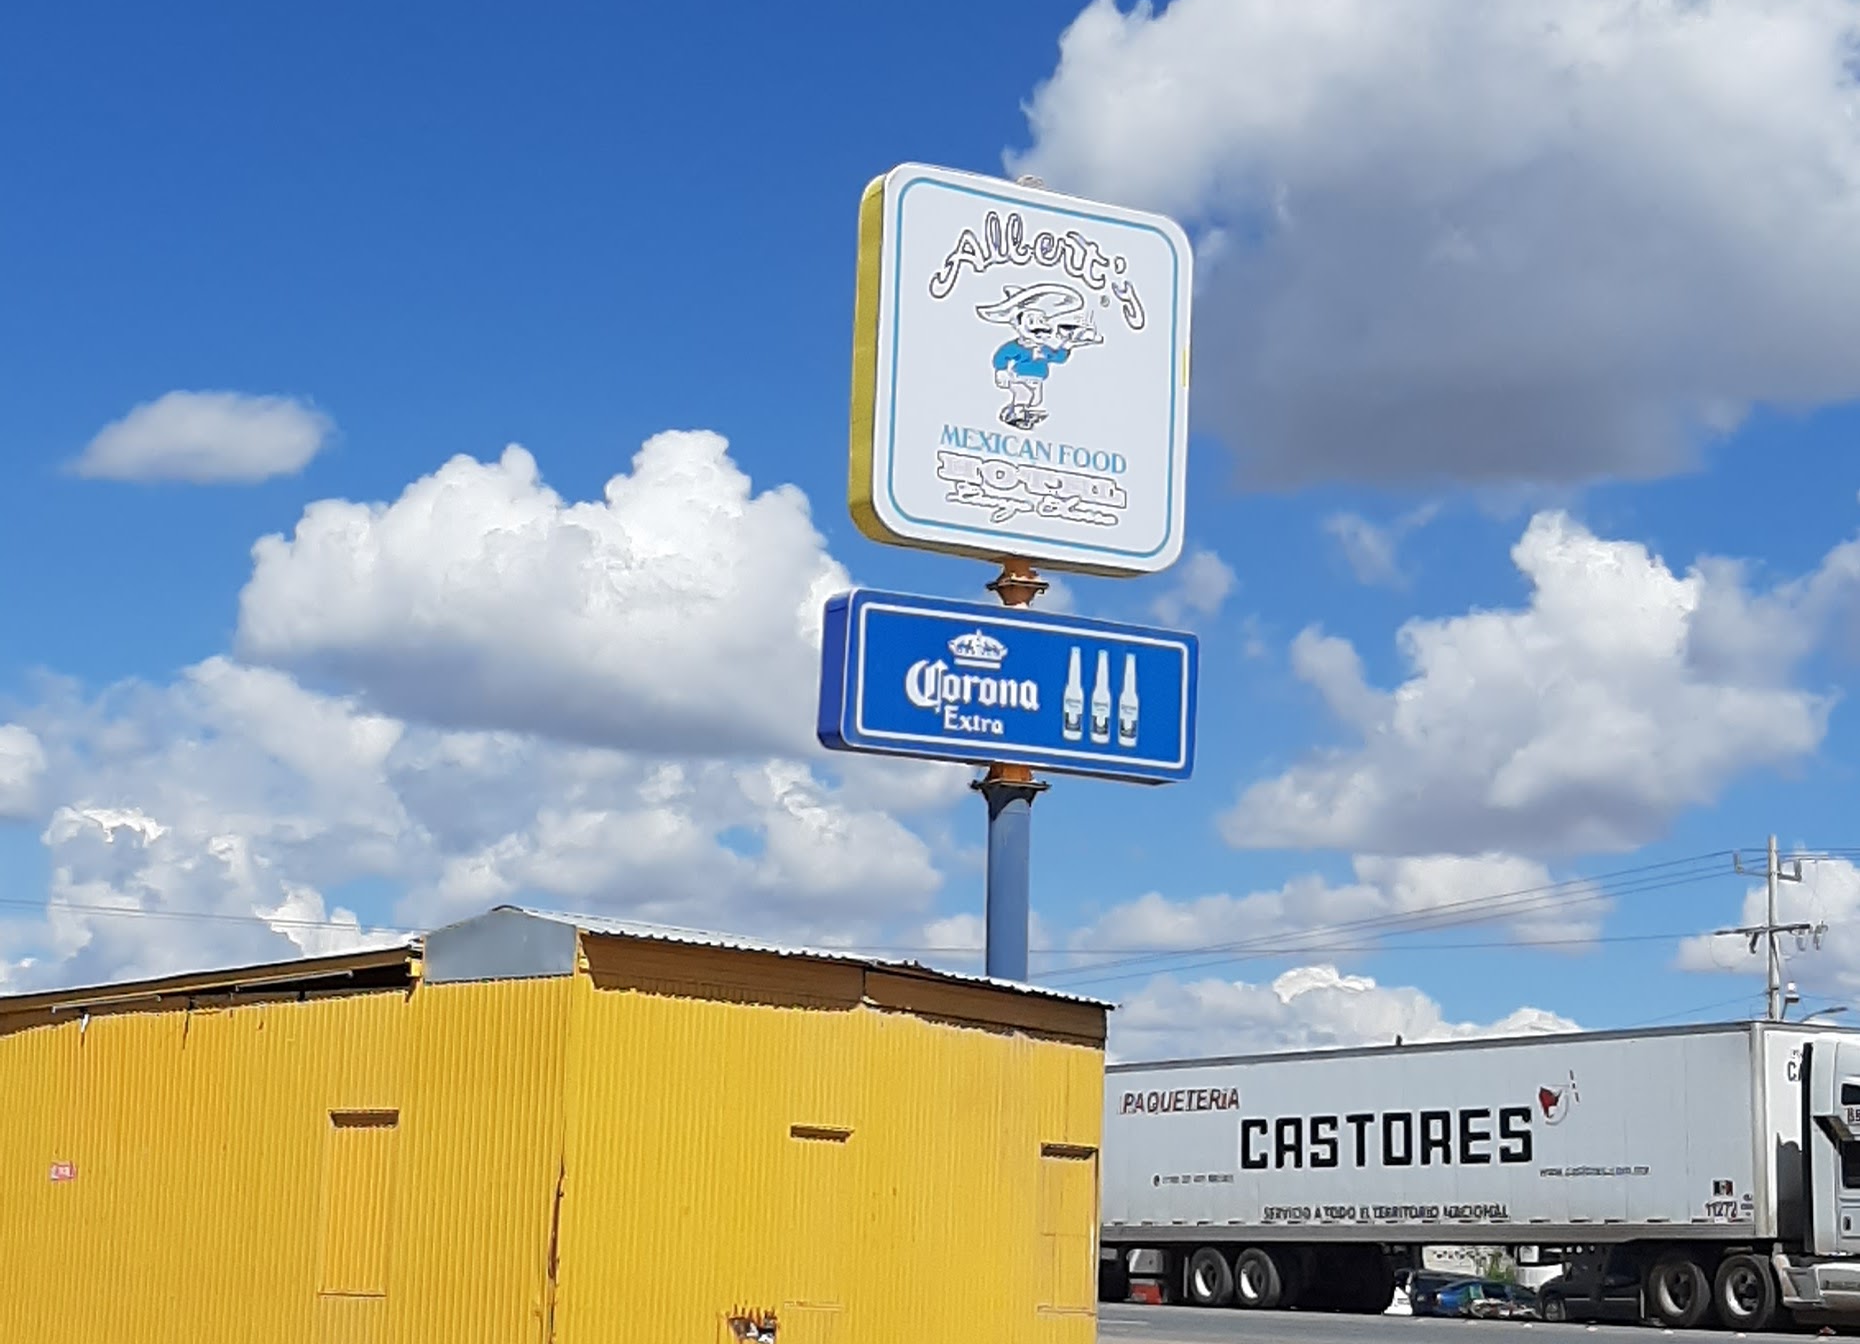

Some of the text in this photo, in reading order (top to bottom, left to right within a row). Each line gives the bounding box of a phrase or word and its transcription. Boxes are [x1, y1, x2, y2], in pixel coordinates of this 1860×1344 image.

[940, 424, 1127, 474] MEXICAN FOOD
[905, 658, 1040, 713] Corona
[943, 704, 1004, 735] Extra
[1241, 1106, 1533, 1169] CASTORES
